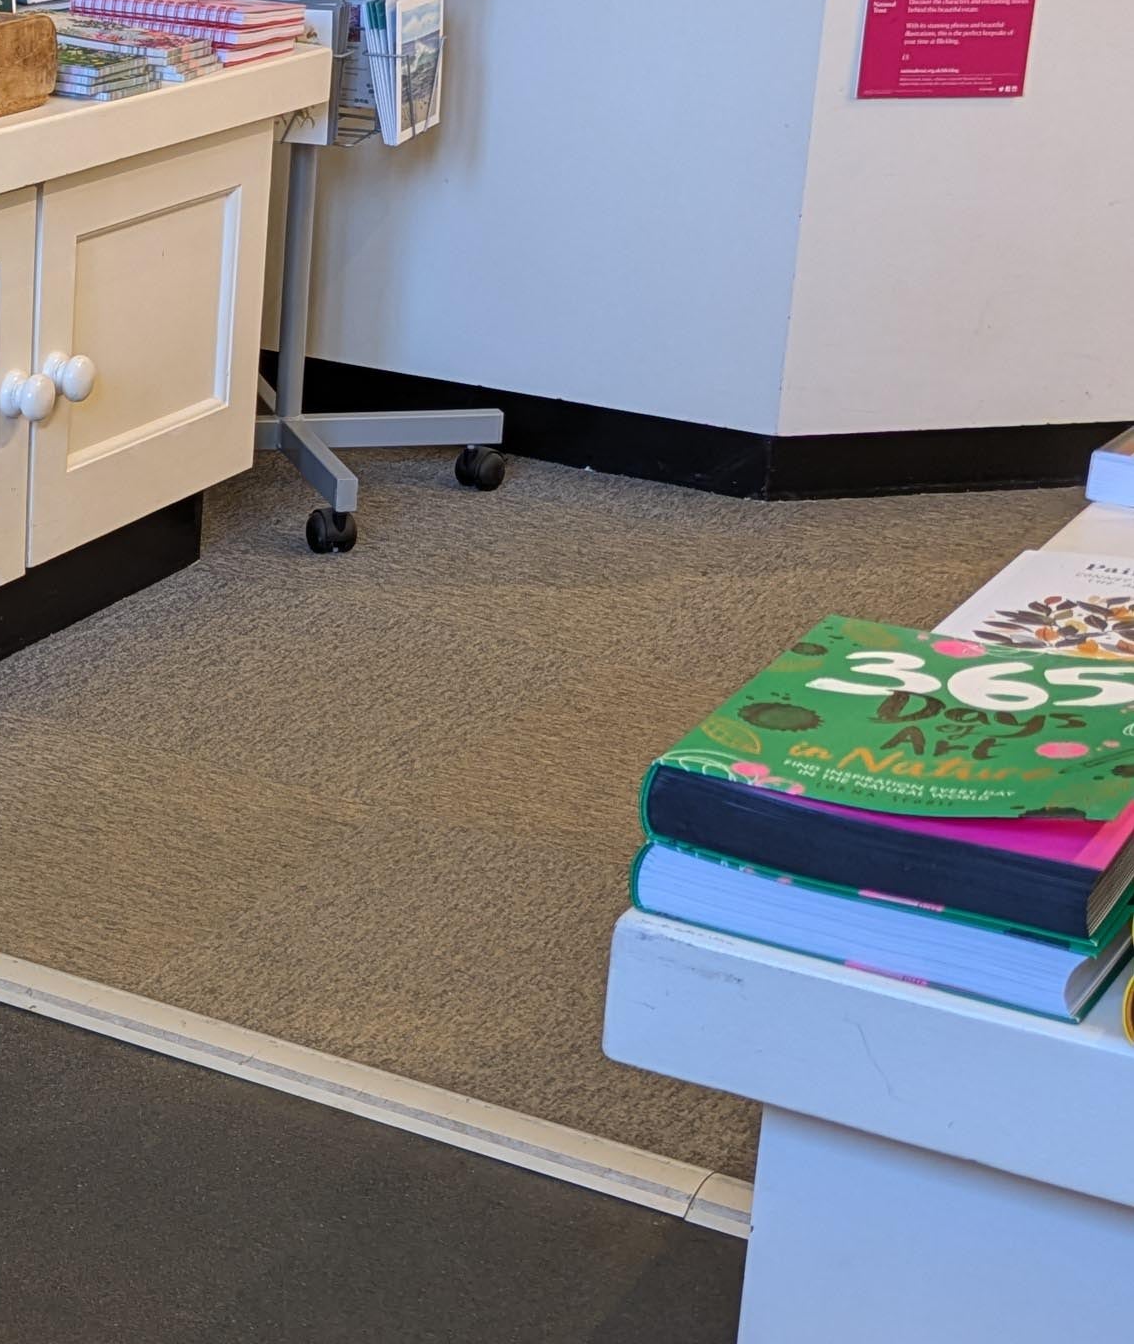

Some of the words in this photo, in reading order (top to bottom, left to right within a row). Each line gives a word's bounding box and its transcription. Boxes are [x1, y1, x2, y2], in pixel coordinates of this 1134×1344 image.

[806, 650, 1134, 712] 365
[867, 692, 1090, 739] Days
[790, 742, 832, 759] in
[838, 746, 1061, 781] Nature
[880, 726, 1006, 760] Art
[784, 758, 822, 772] FIND
[825, 769, 924, 792] INSPIRATION
[928, 786, 974, 796] EVERY
[798, 769, 817, 777] IN
[822, 773, 851, 784] THE
[853, 780, 923, 797] NATURAL
